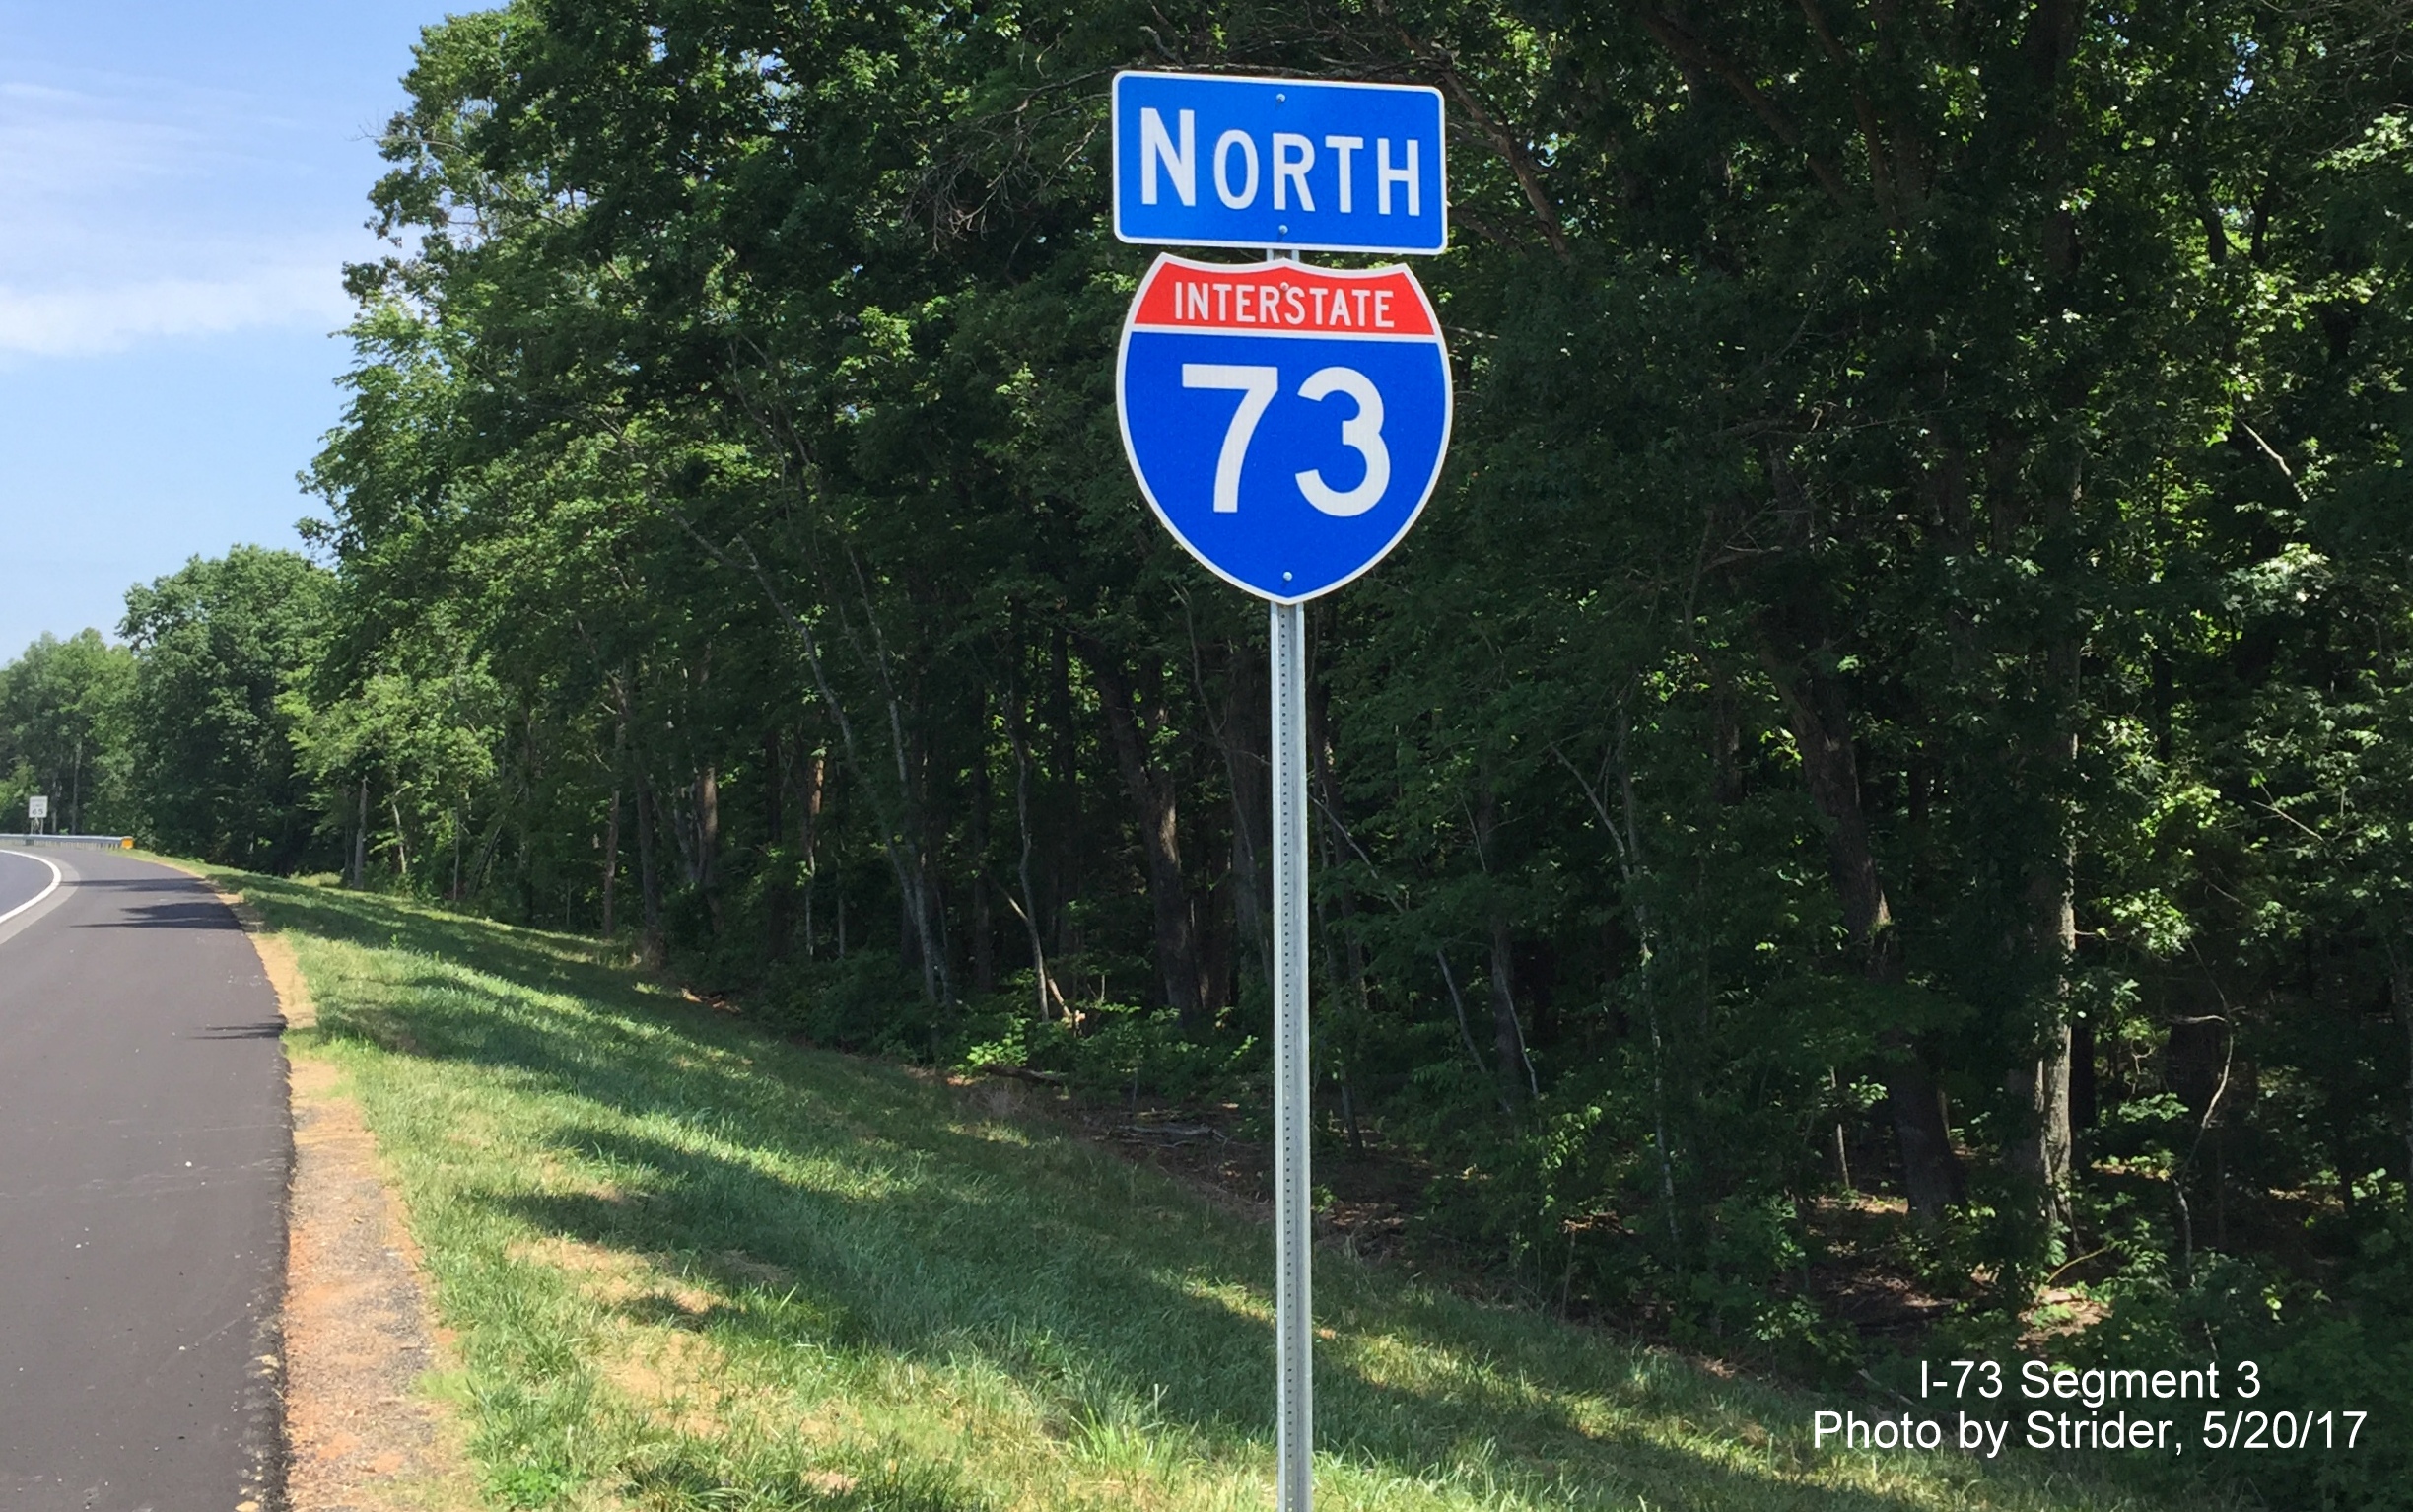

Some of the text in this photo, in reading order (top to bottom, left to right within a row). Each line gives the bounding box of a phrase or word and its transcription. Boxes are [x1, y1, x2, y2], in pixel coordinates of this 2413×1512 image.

[1139, 106, 1421, 217] NORTH
[1174, 281, 1395, 328] INTERSTATE
[1182, 363, 1391, 518] 73
